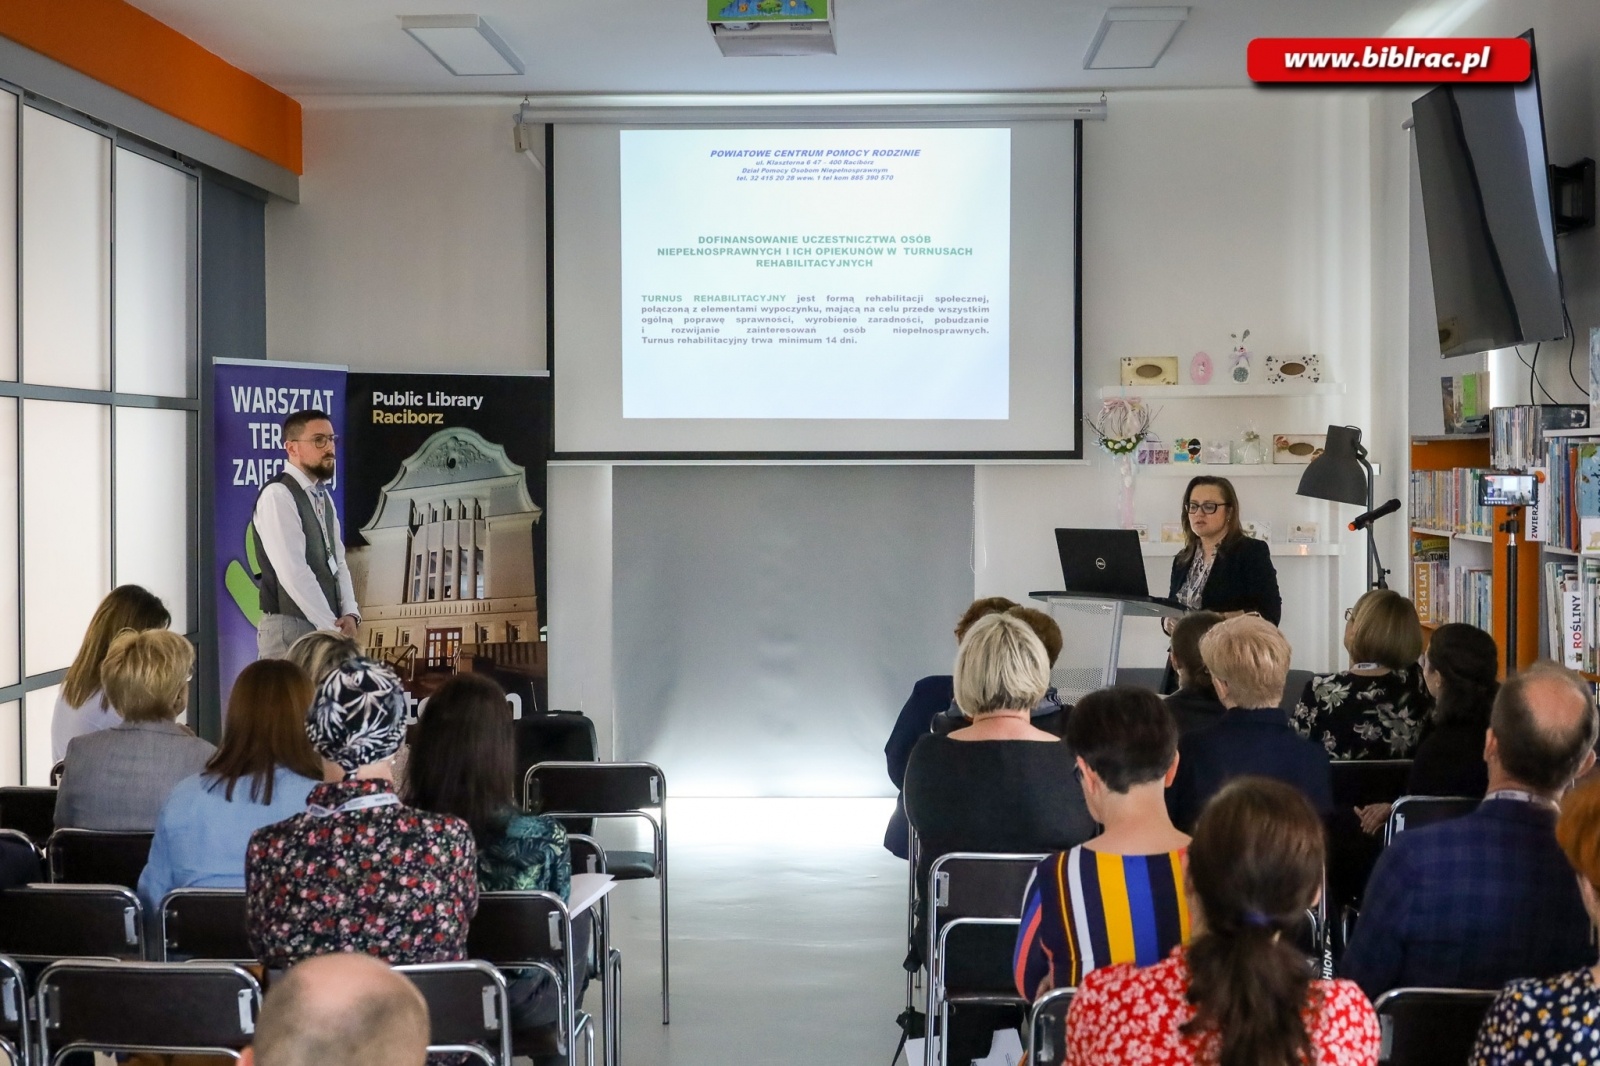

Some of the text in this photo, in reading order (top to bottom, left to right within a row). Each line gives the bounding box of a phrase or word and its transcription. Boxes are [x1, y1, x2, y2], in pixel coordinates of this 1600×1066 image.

[710, 149, 922, 158] POWIATOWE CENTRUM POMOCY RODZINIE
[760, 167, 789, 175] Pomocy
[820, 167, 888, 175] Niepełnosprawnym
[697, 233, 932, 245] DOFINANSOWANIE UCZESTNICZTWA OSÓB
[656, 245, 973, 257] NIEPEŁNOSPRAWNYCH I ICH OPIEKUNÓW W TURNUSACH
[755, 258, 874, 268] REHABILITACYJNYCH
[641, 294, 990, 305] TURNUS REHABILITACYJNY jest formą rehabilitacji społecznej,
[641, 305, 690, 315] połączoną
[700, 304, 758, 313] elementami
[760, 304, 823, 315] wypoczynku,
[825, 304, 861, 315] mającą
[878, 304, 900, 313] celu
[902, 305, 935, 315] przede
[937, 305, 990, 315] wszystkim
[641, 315, 990, 326] ogólną poprawę sprawności, wyrobienie zaradności, pobudzanie
[641, 325, 990, 336] i rozwijanie zainteresowań osób niepełnosprawnych.
[641, 336, 858, 346] Turnus rehabilitacyjny trwa minimum 14 dni.
[231, 385, 334, 416] WARSZTAT
[372, 390, 484, 411] Public Library
[372, 408, 444, 425] Raciborz
[1419, 567, 1428, 618] 12-14 LAT
[1570, 595, 1582, 649] ROŚLINY
[1322, 949, 1333, 981] HION
